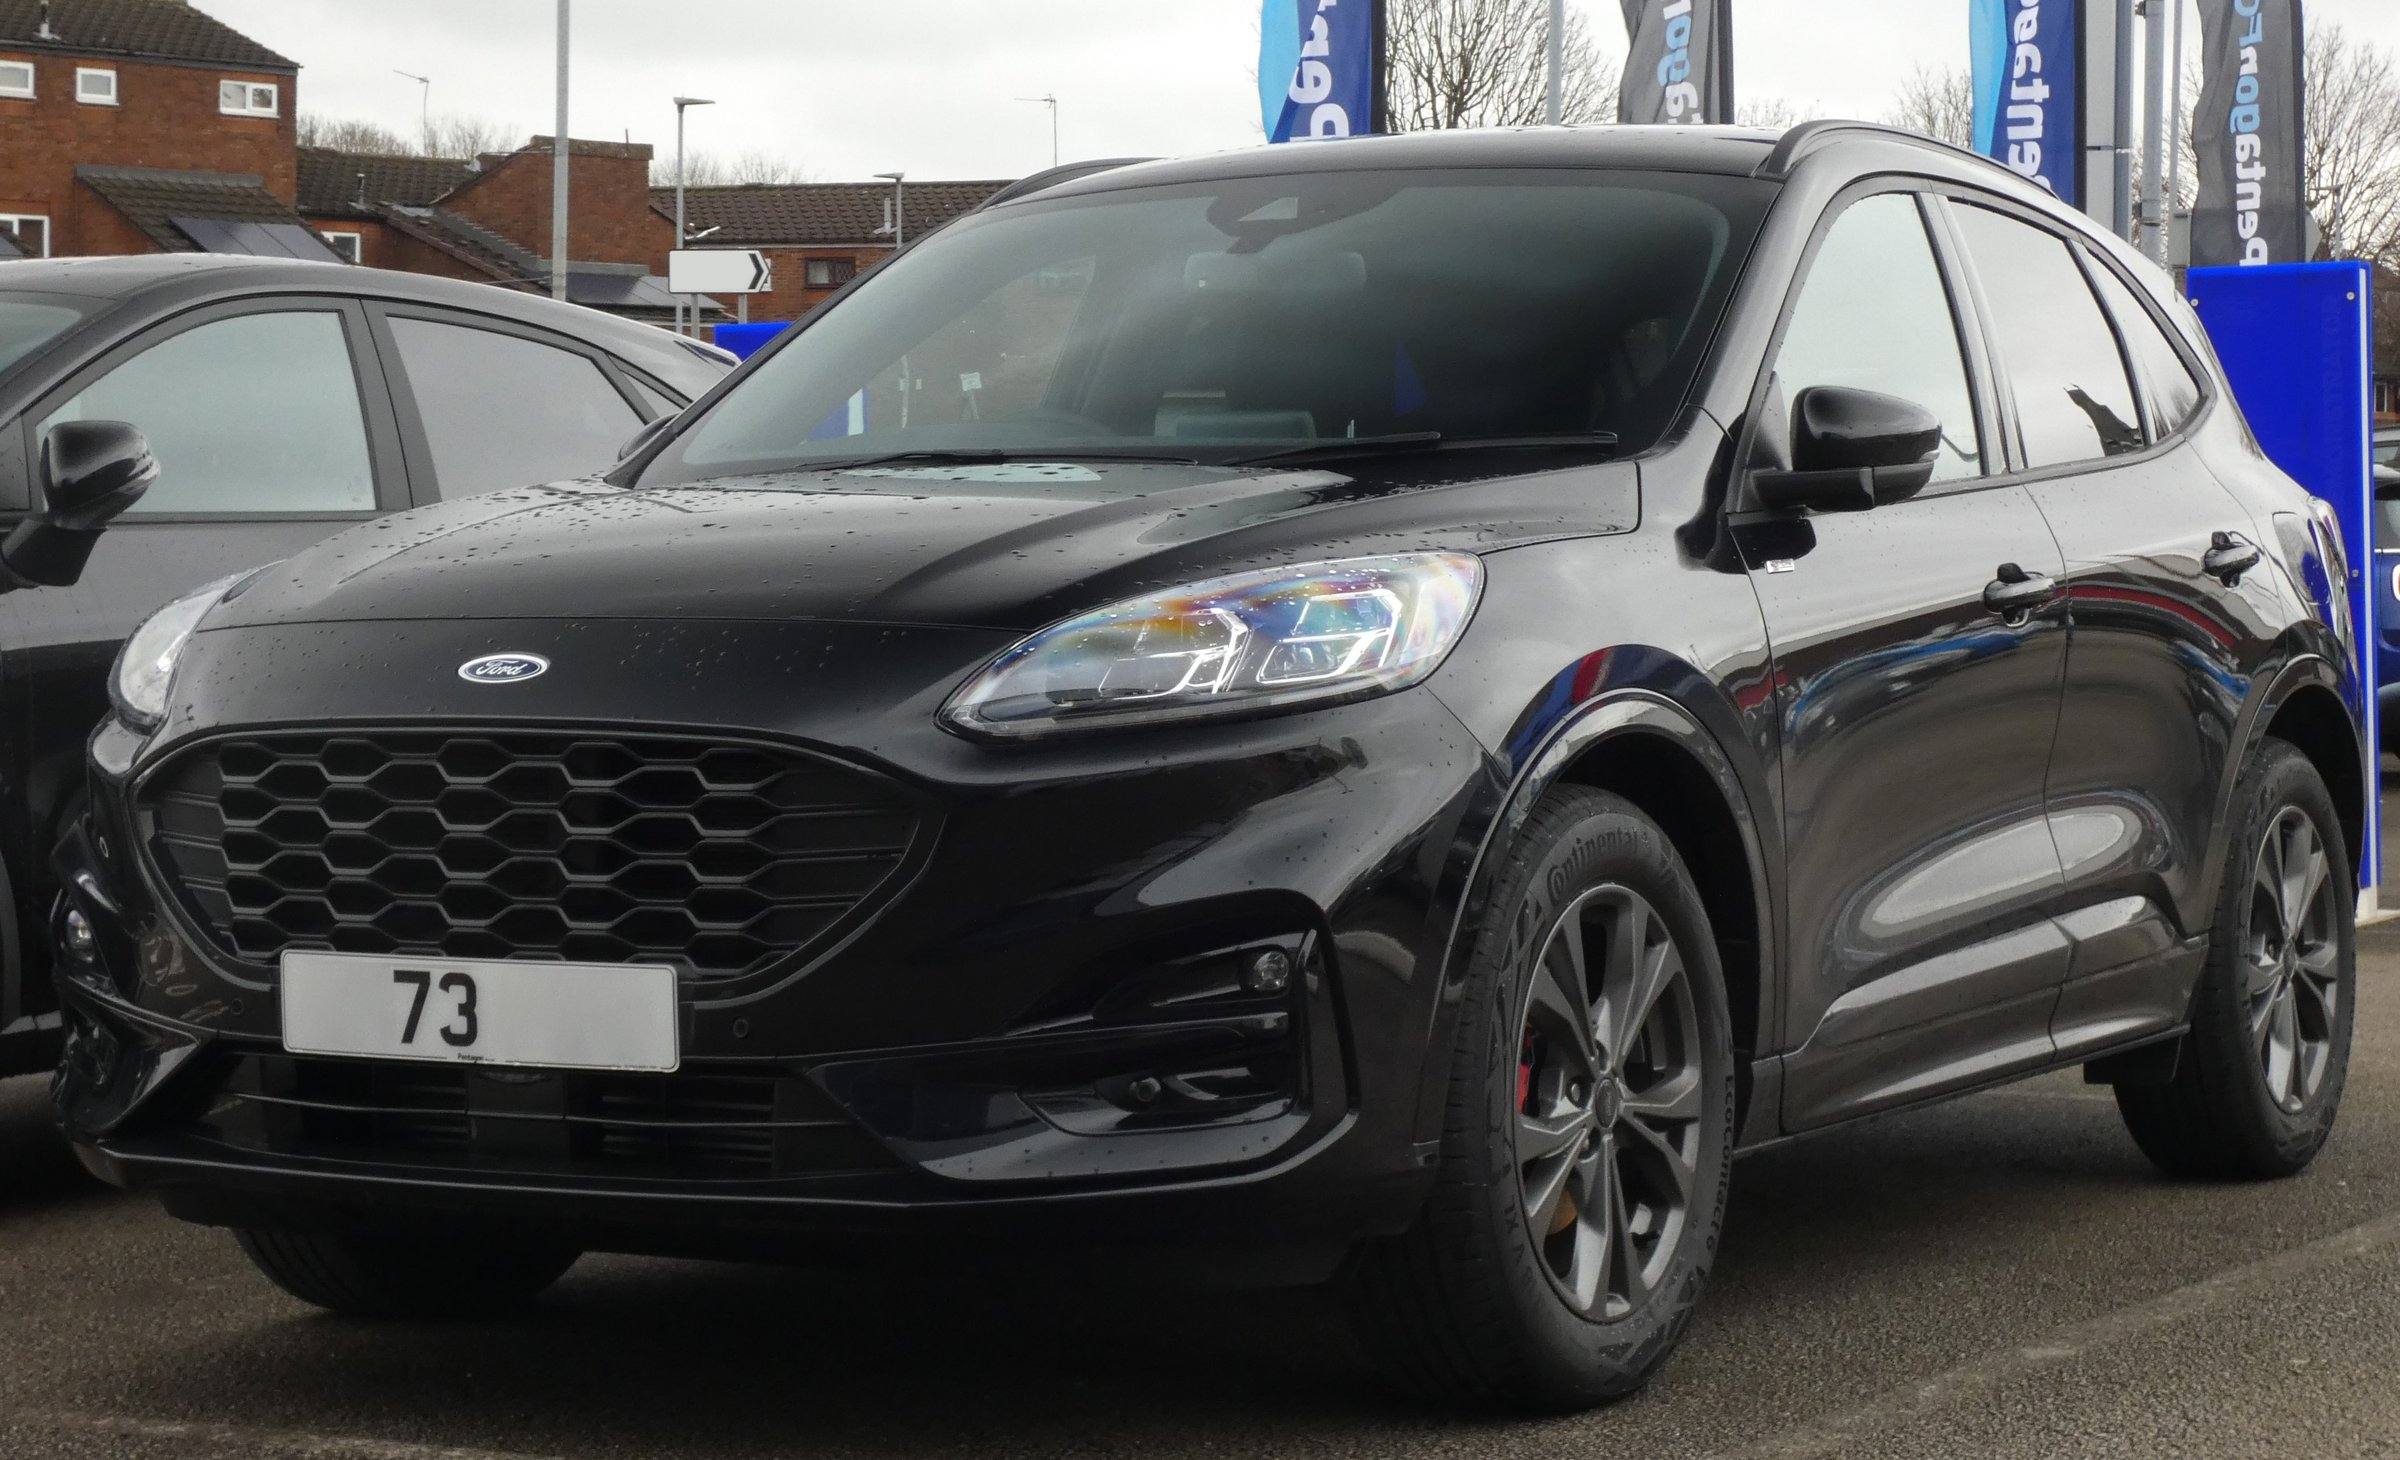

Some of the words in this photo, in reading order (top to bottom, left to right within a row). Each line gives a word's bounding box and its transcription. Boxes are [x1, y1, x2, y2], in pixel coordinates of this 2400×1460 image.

[475, 659, 528, 675] Ford
[1547, 827, 1638, 904] Continental
[393, 969, 478, 1047] 73
